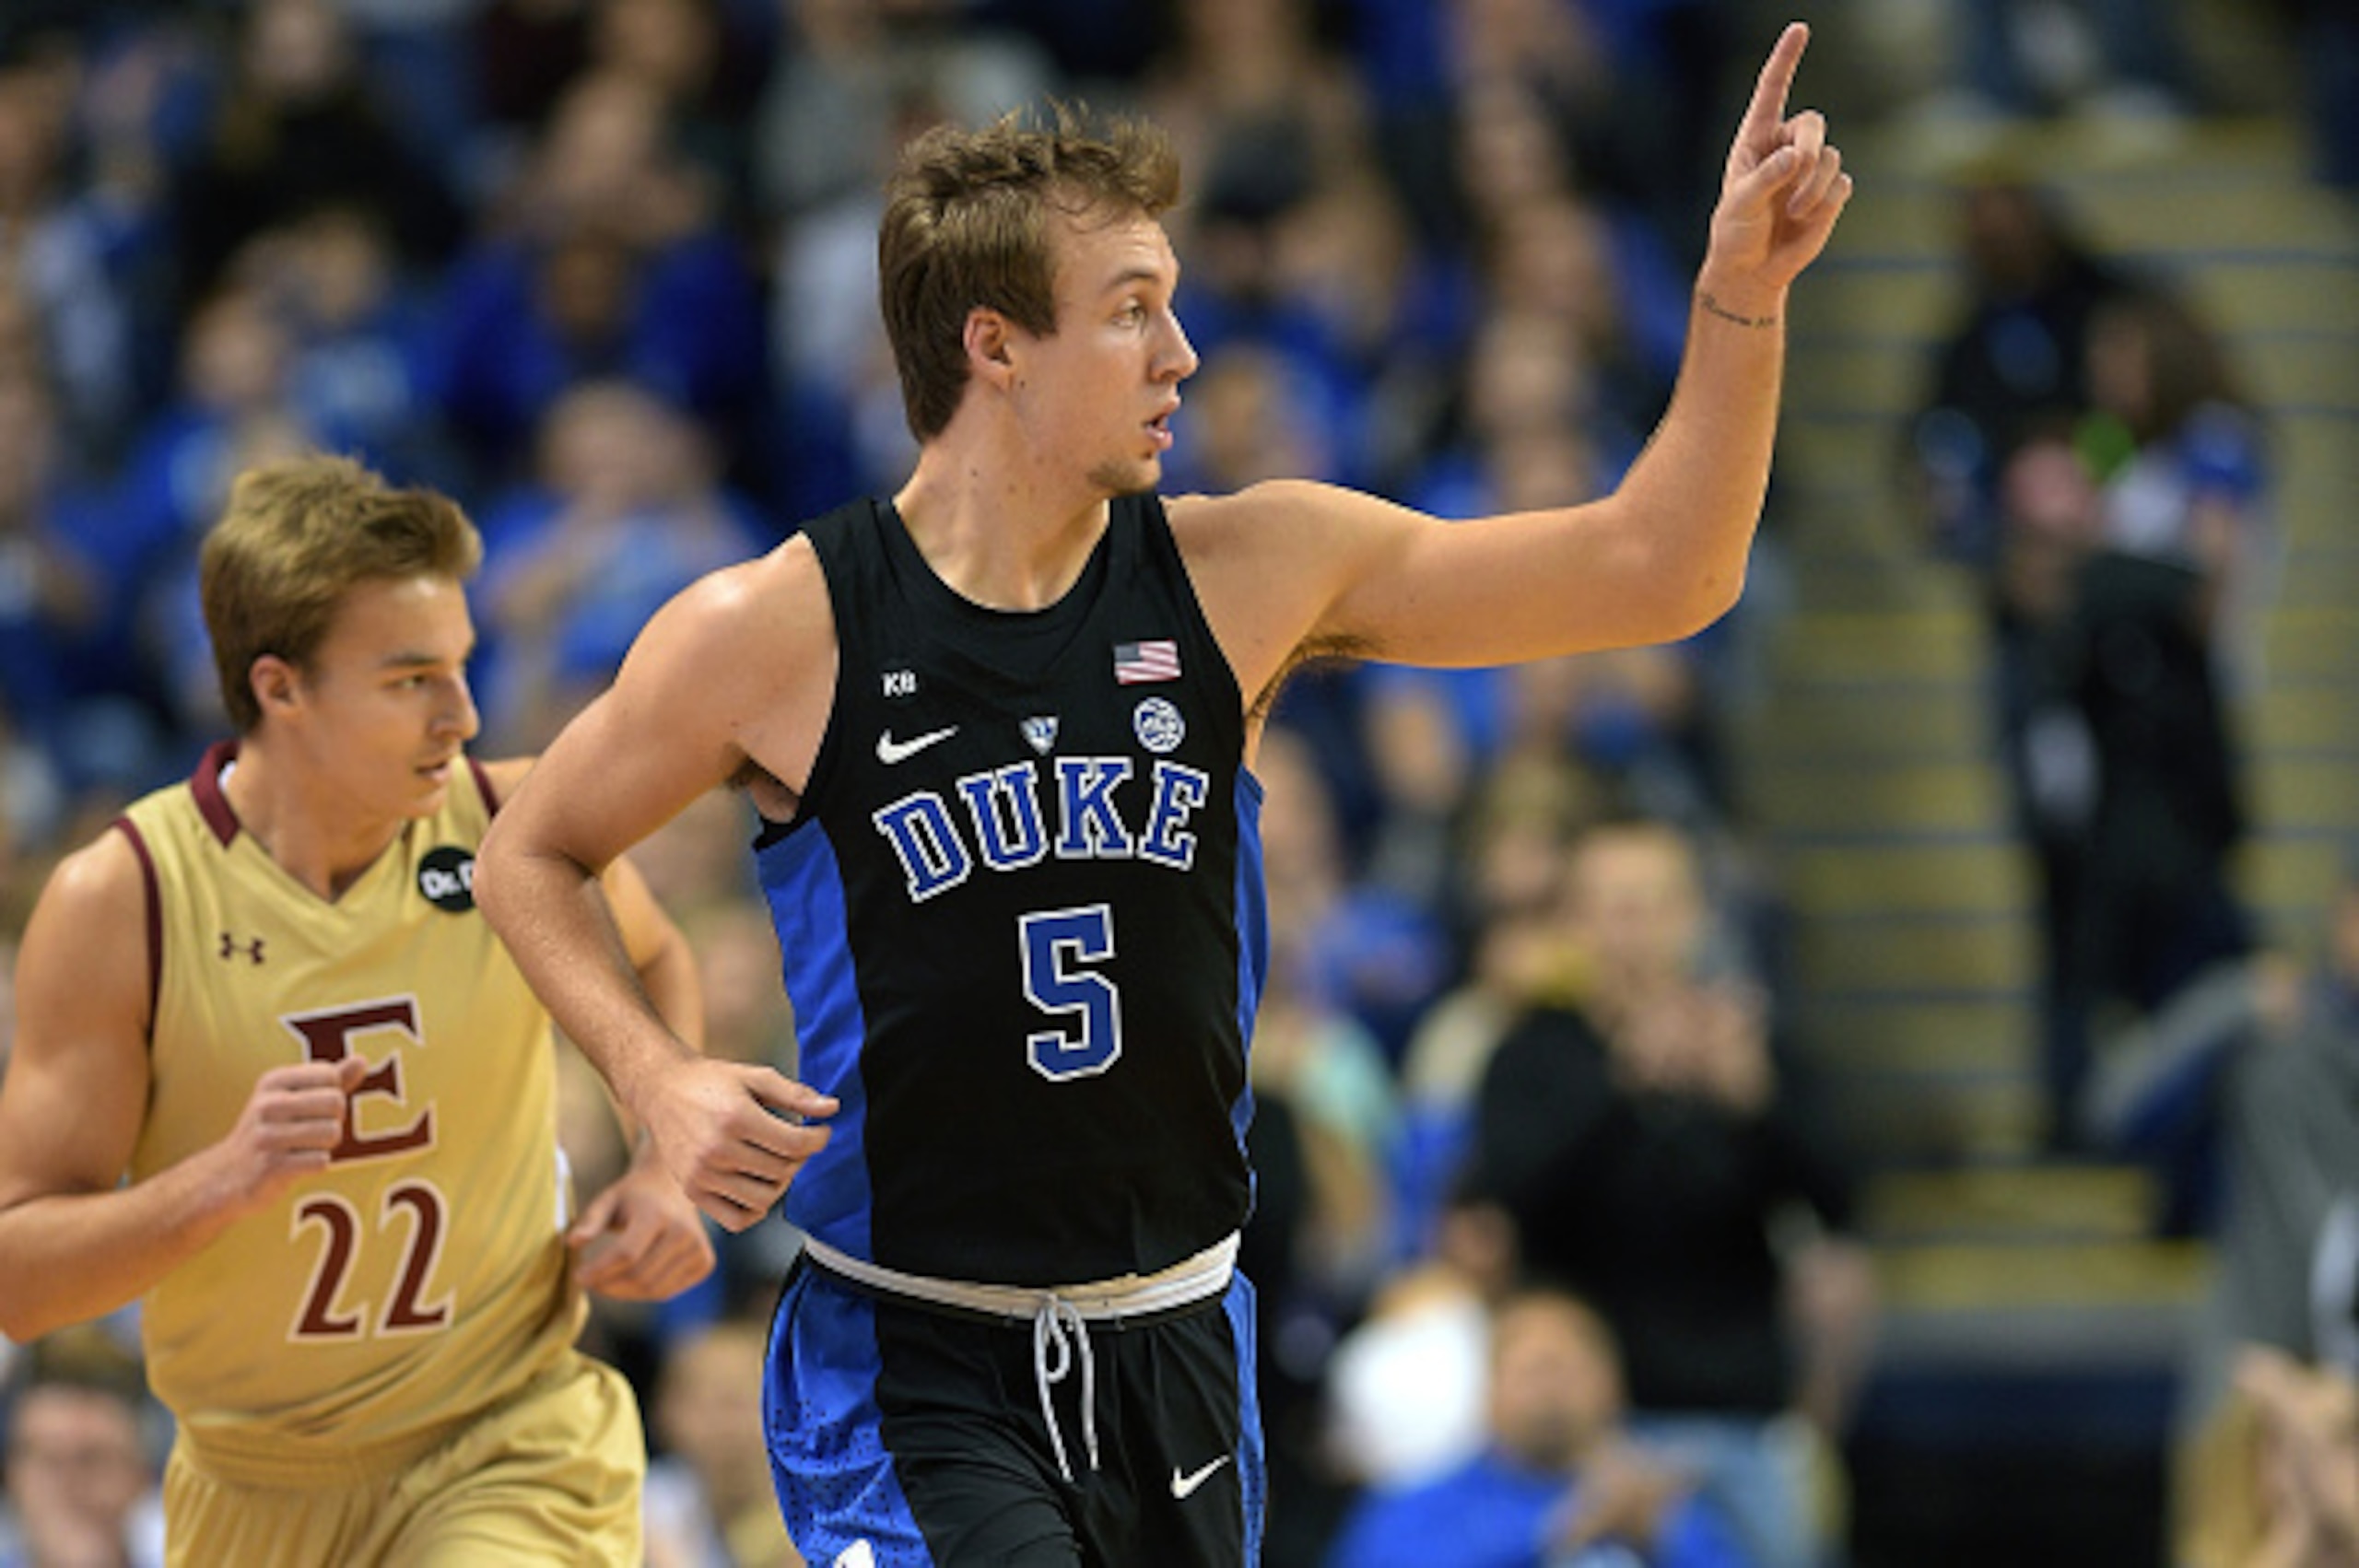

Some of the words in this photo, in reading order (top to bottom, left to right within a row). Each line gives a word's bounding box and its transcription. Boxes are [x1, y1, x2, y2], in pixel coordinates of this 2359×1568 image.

[872, 755, 1209, 903] DUKE
[1017, 902, 1122, 1082] 5
[279, 992, 435, 1169] E
[286, 1177, 456, 1343] 22
